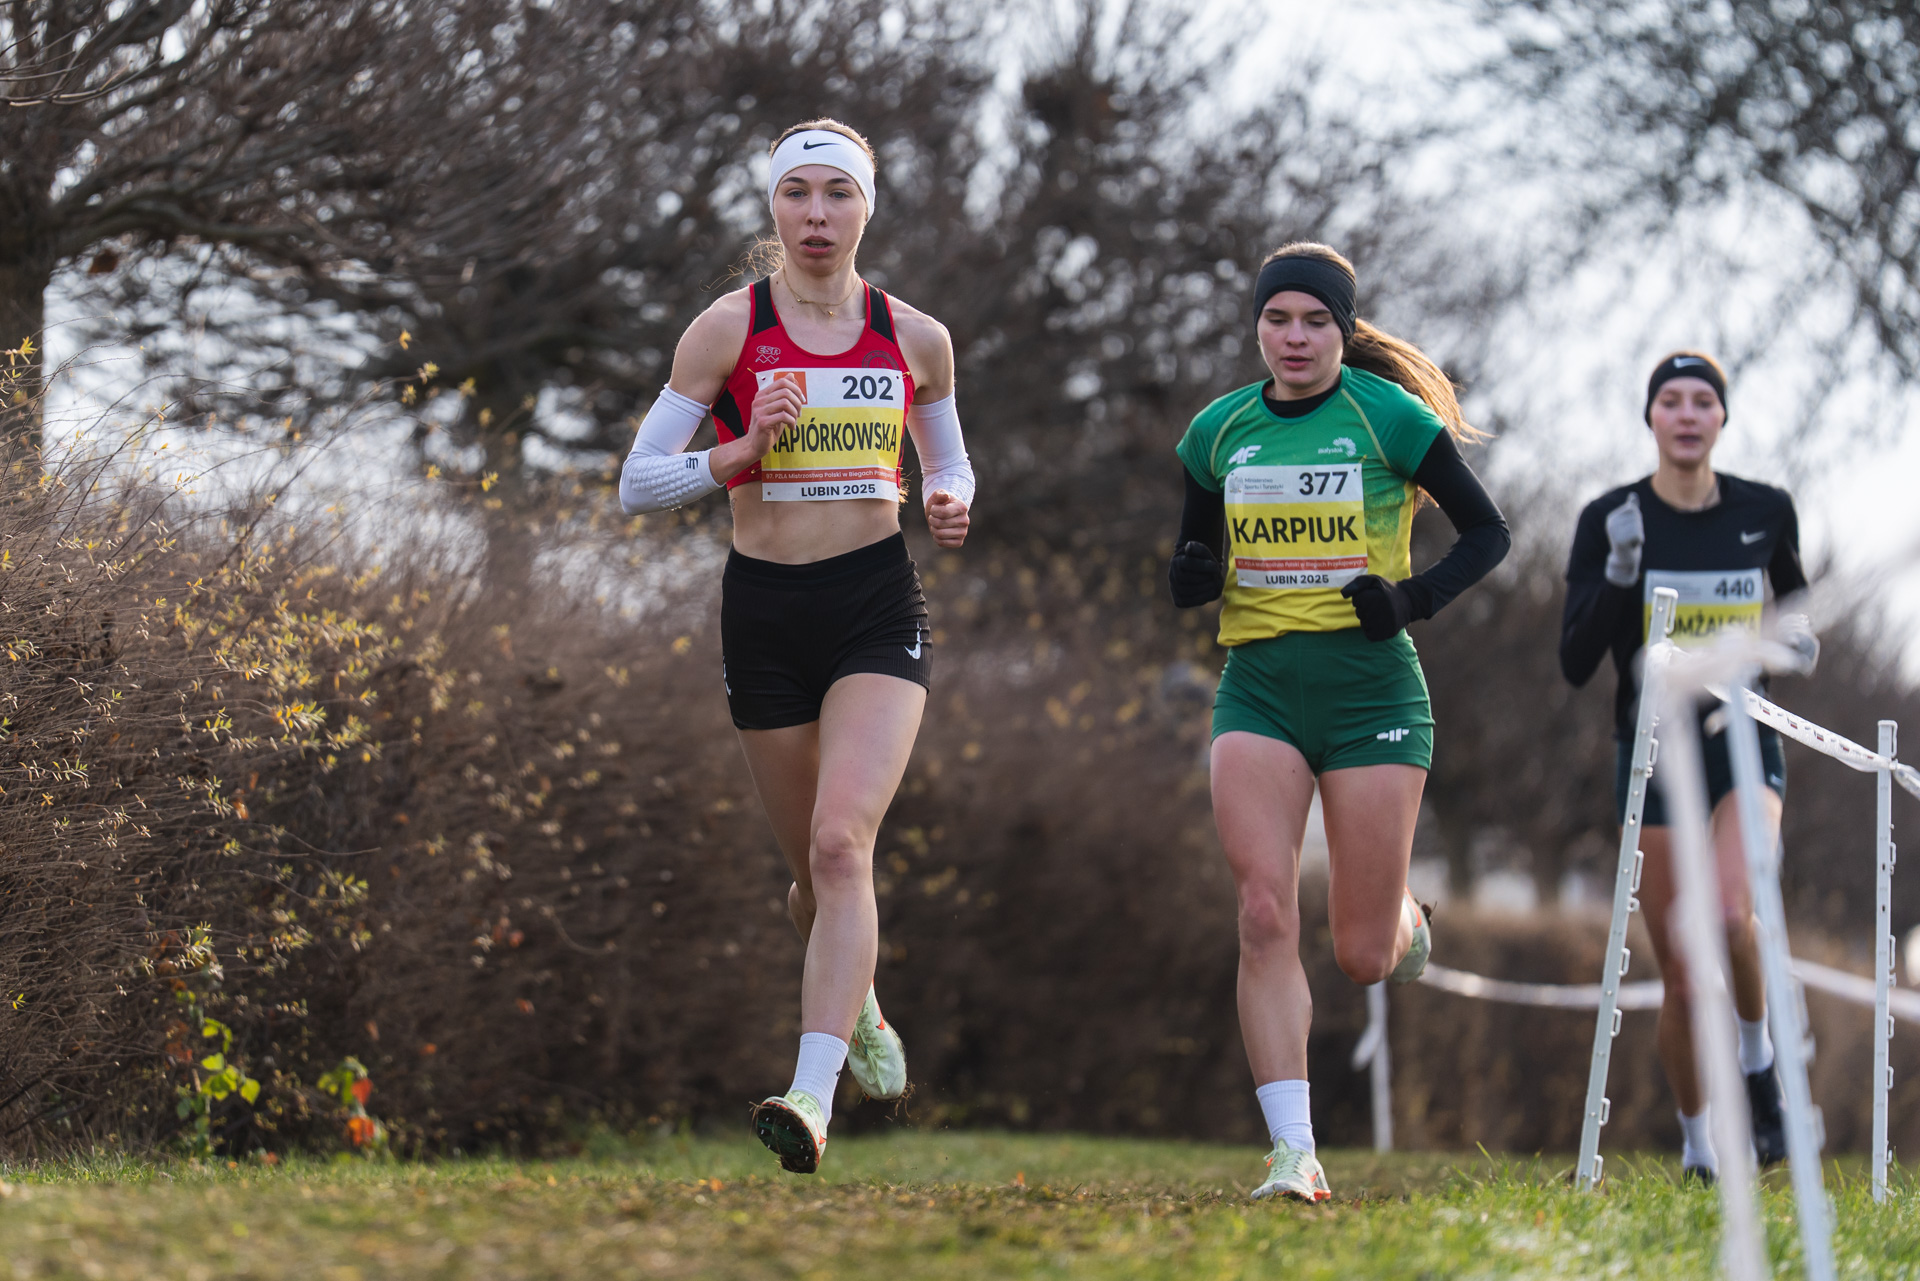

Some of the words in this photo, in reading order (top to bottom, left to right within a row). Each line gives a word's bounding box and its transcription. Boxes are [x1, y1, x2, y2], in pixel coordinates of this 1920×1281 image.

[842, 375, 893, 400] 202
[772, 417, 897, 453] APIÓRKOWSKA
[801, 486, 840, 497] LUBIN
[843, 484, 876, 495] 2025
[1299, 471, 1348, 495] 377
[1232, 516, 1358, 544] KARPIUK
[1265, 575, 1297, 584] LUBIN
[1300, 575, 1329, 584] 2025
[1714, 577, 1755, 600] 440
